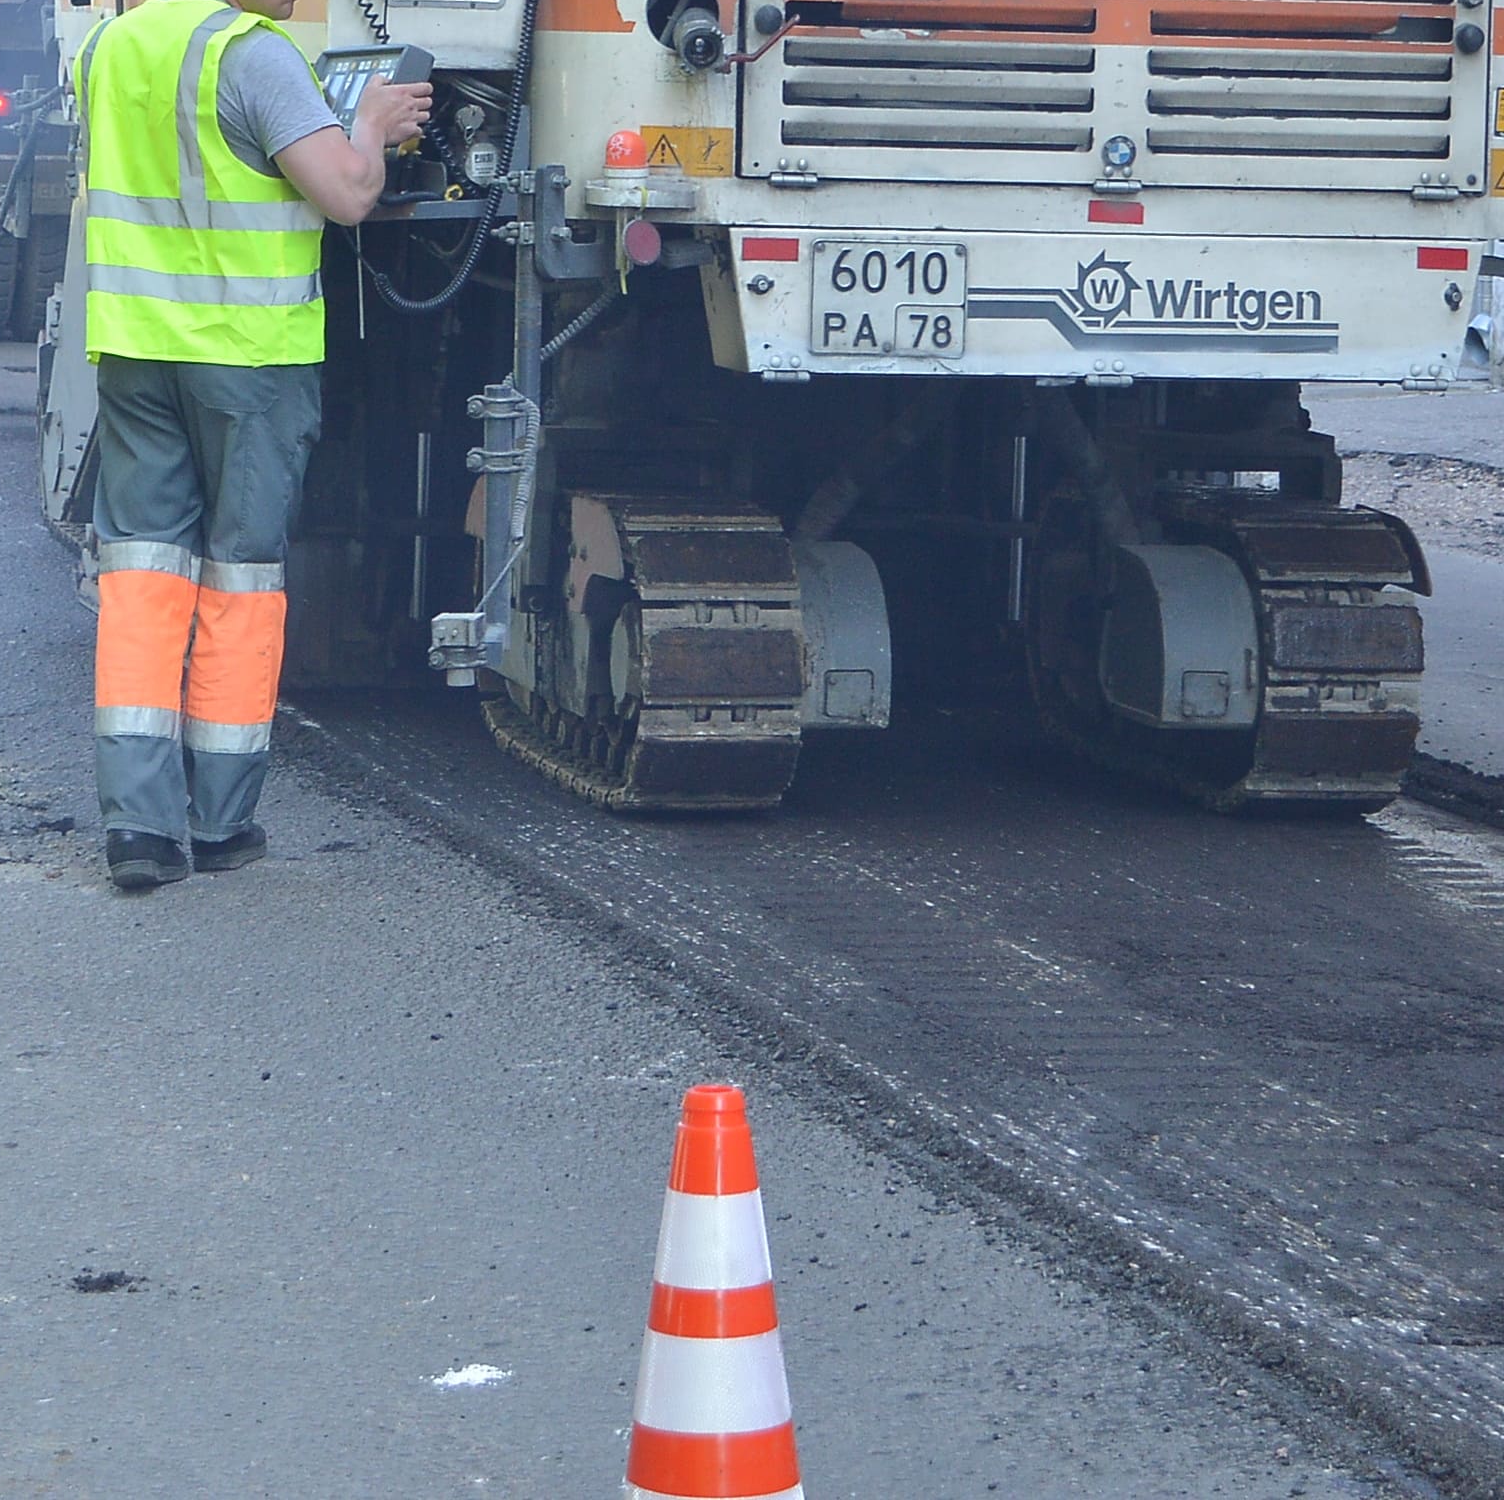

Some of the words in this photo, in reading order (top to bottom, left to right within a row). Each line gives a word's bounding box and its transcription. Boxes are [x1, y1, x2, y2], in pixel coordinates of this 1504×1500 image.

[831, 248, 948, 295] 6010
[1089, 278, 1120, 305] W
[1146, 279, 1322, 331] Wirtgen
[908, 313, 952, 349] 78
